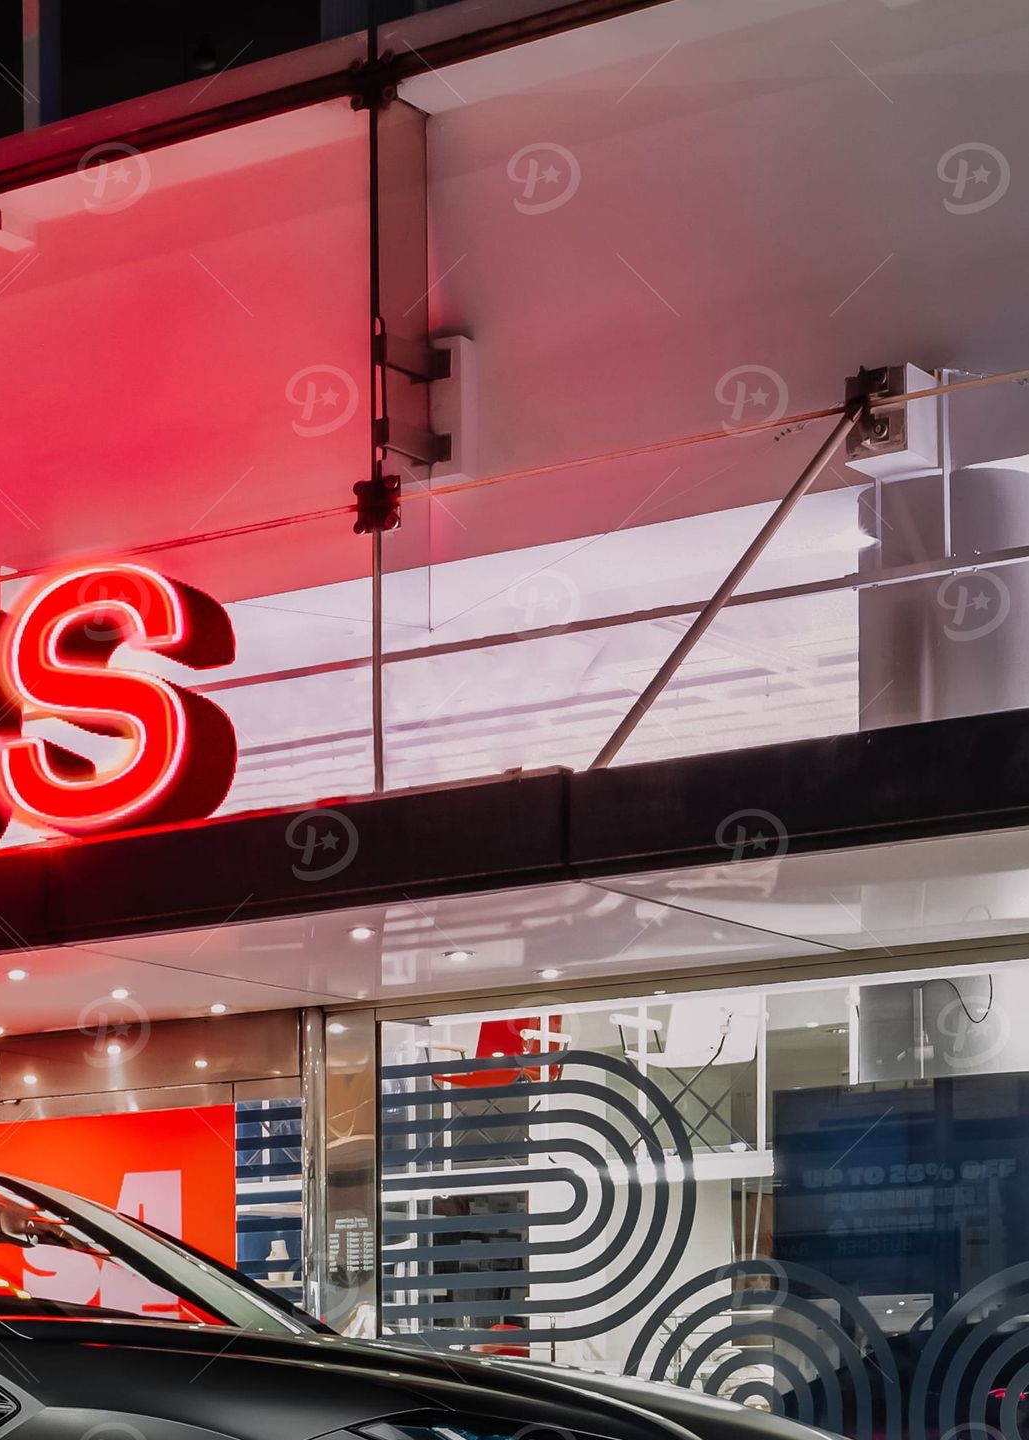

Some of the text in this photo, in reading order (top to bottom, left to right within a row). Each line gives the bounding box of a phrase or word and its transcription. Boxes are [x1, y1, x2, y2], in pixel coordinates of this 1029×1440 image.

[802, 1158, 1017, 1189] UP TO 25% OFF
